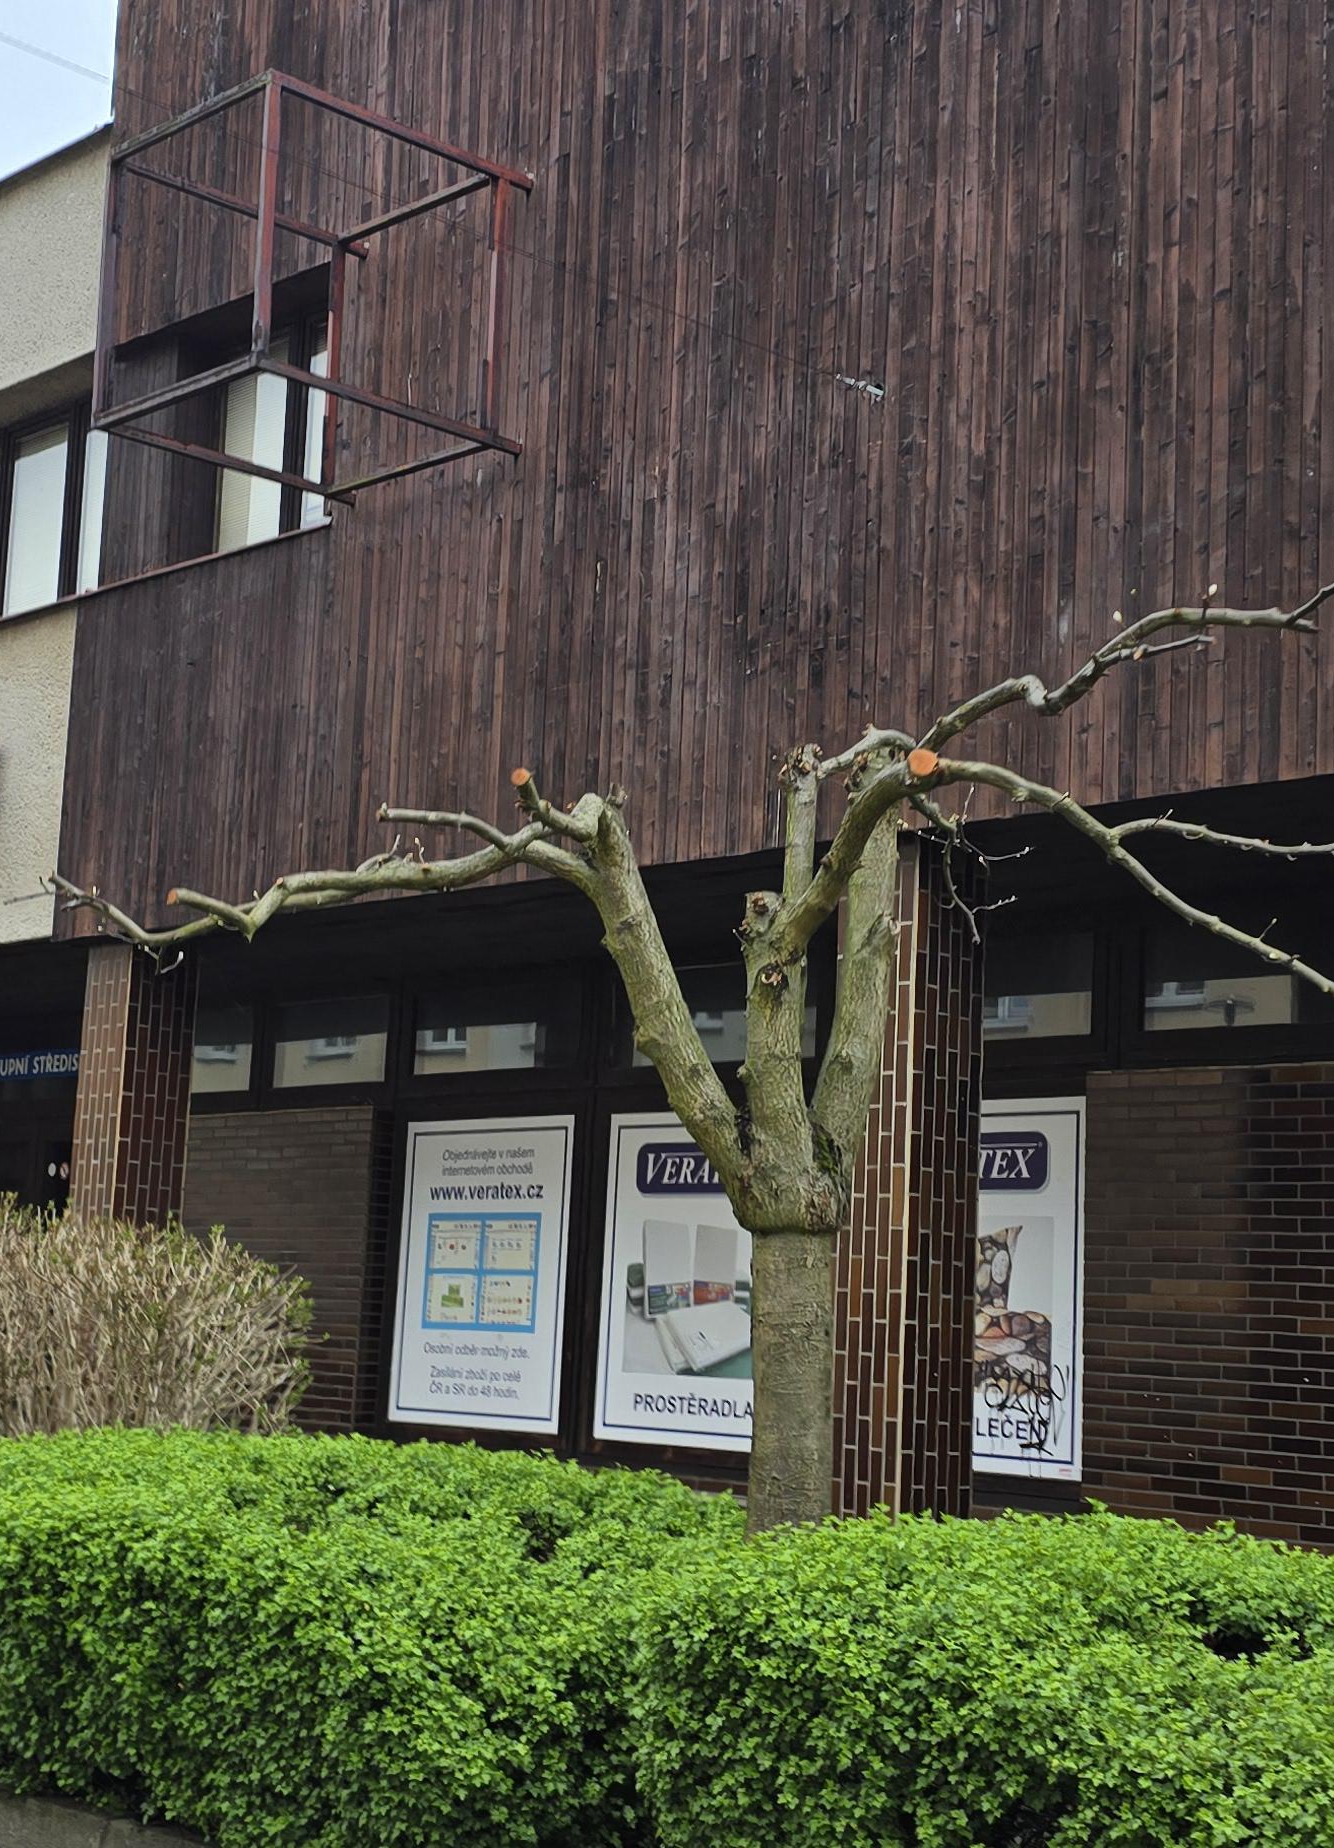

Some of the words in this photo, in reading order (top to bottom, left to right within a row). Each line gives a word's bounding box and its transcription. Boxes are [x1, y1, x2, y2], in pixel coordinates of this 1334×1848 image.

[32, 1052, 79, 1074] STŘEDIS
[442, 1149, 497, 1163] Objednávejte
[506, 1147, 535, 1158] našem
[442, 1164, 495, 1176] internetovém
[496, 1162, 533, 1175] obchodě
[646, 1153, 720, 1185] VERA
[429, 1181, 544, 1201] www.veratex.cz
[489, 1372, 501, 1383] po
[633, 1393, 754, 1420] PROSTĚRADLA
